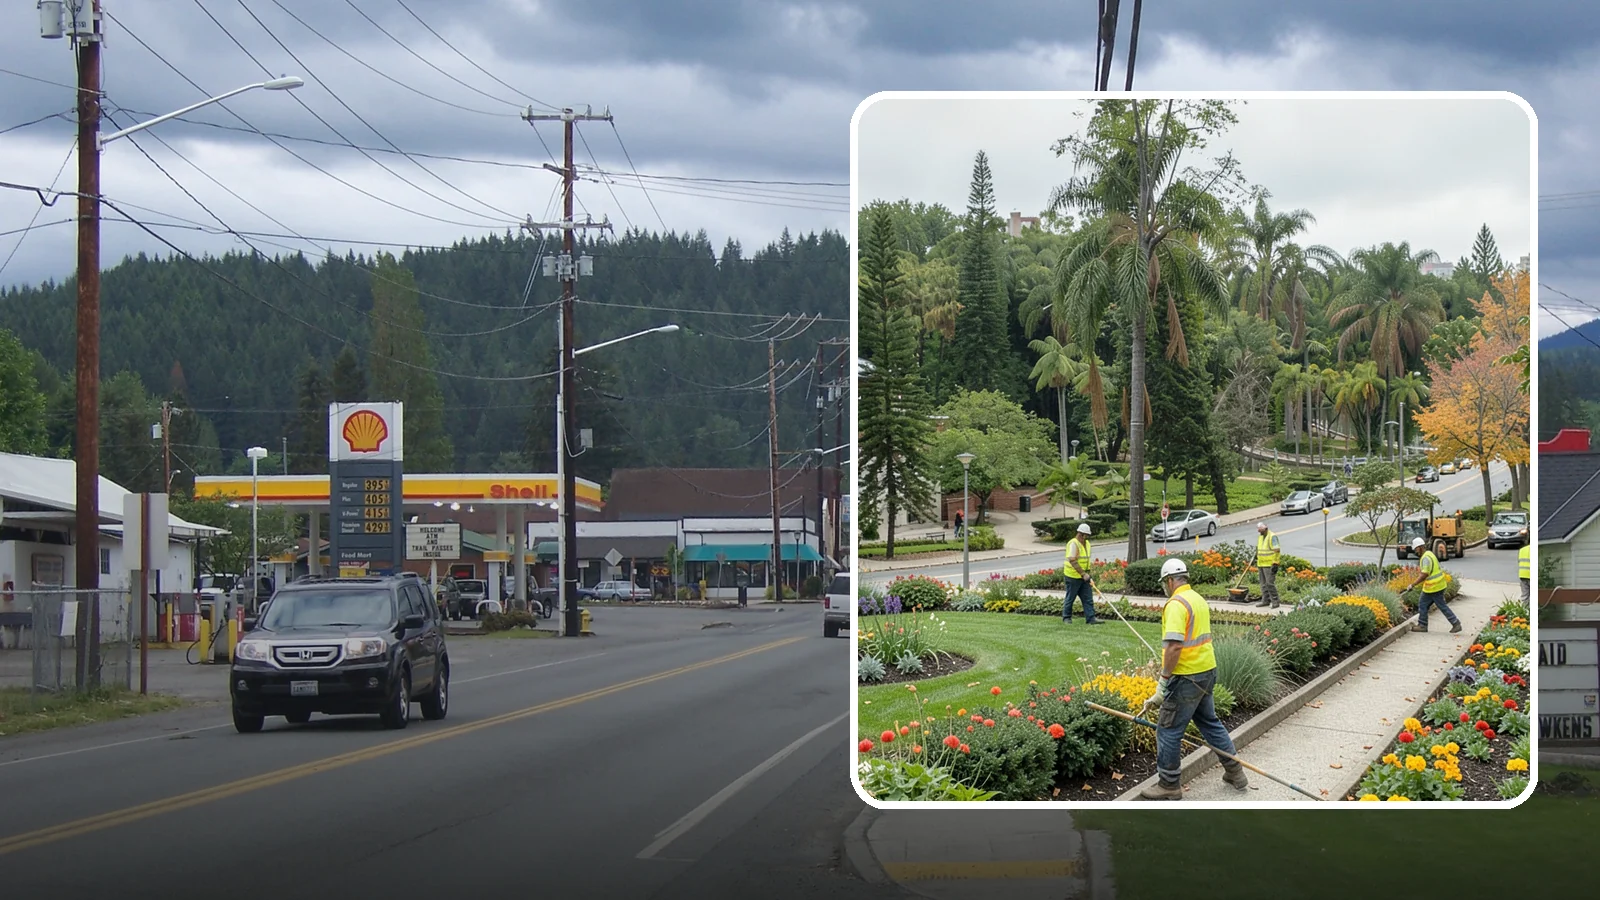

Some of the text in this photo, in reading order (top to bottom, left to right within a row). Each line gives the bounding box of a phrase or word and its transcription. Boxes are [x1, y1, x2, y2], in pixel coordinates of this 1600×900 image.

[366, 480, 383, 490] 395
[490, 484, 547, 498] Shell
[366, 494, 383, 504] 405
[366, 508, 383, 518] 415
[366, 522, 383, 532] 429
[1538, 643, 1566, 665] AID
